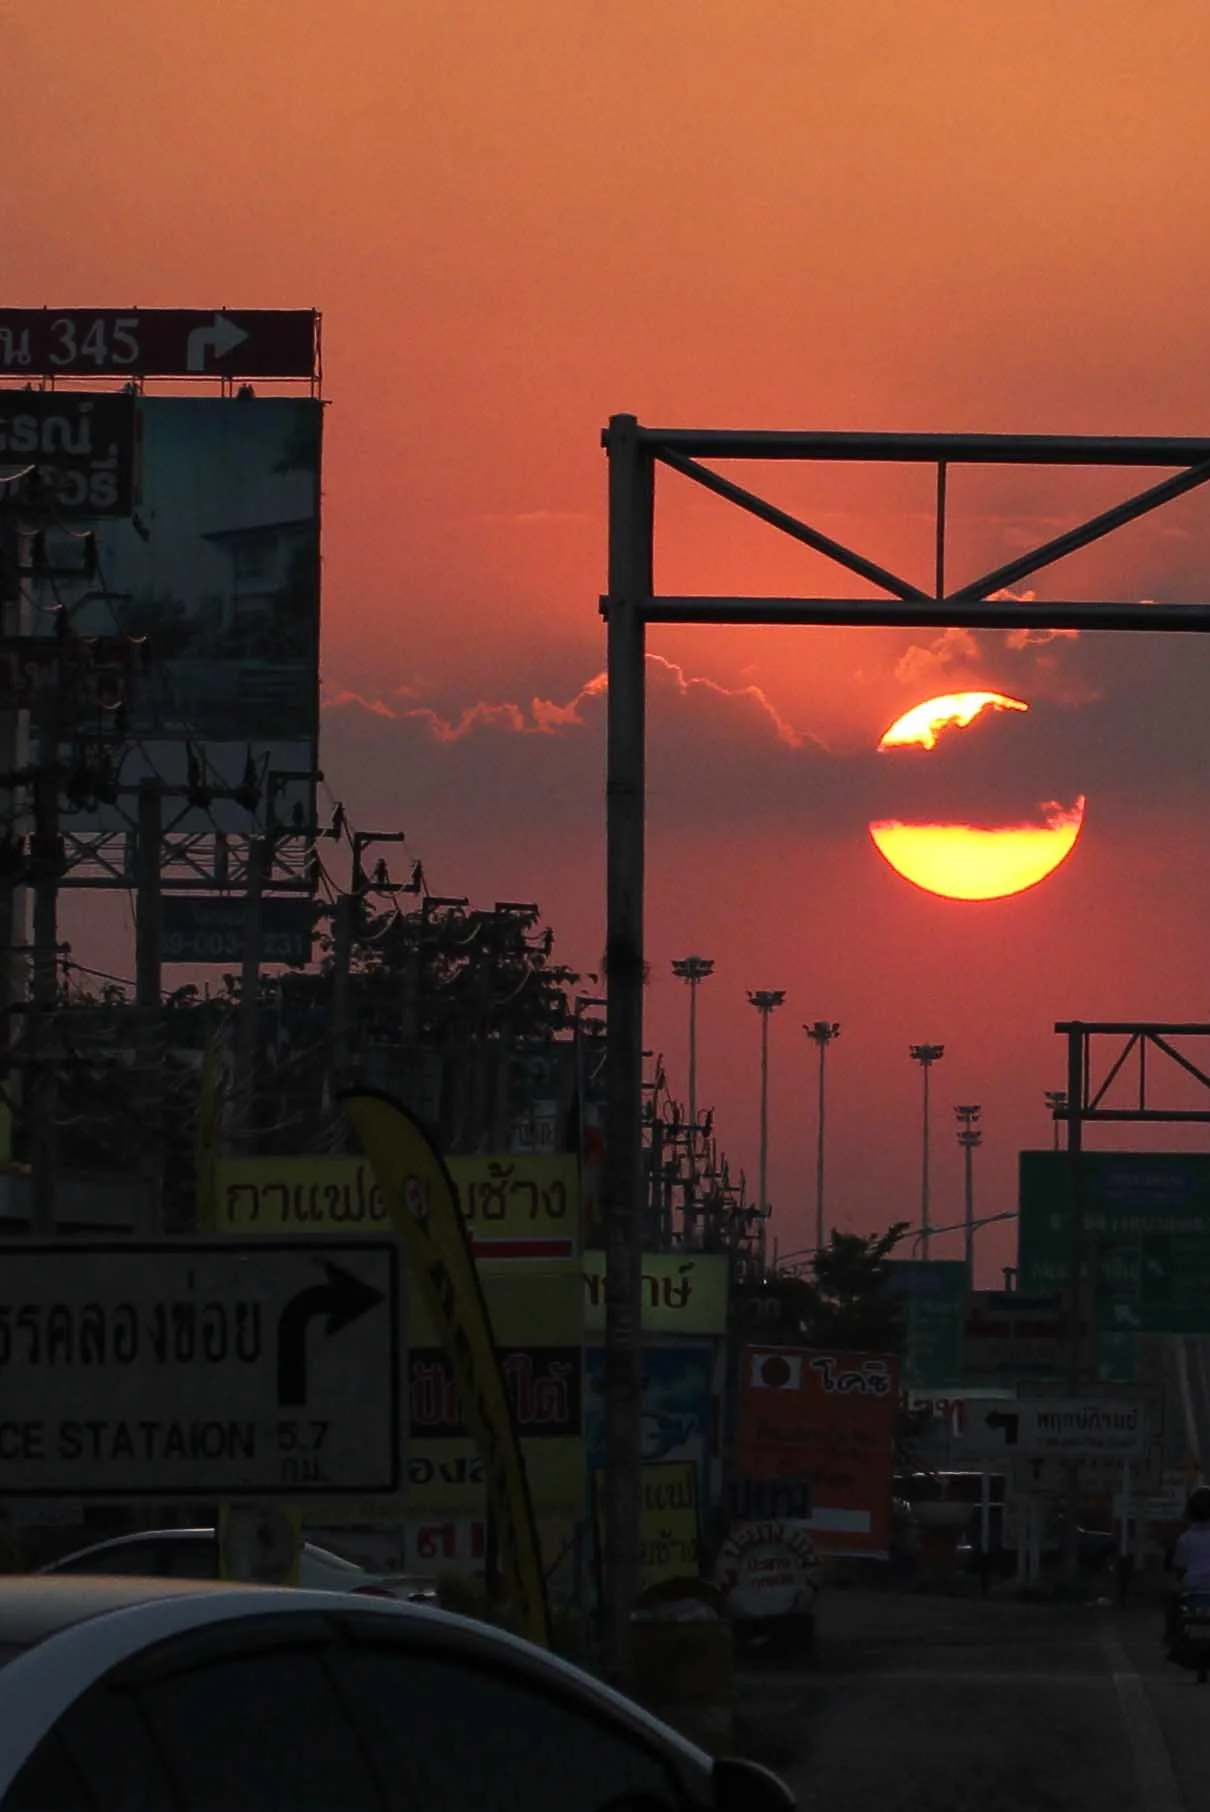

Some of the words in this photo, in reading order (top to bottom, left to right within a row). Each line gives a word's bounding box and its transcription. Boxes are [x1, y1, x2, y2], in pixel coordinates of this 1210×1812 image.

[49, 318, 140, 366] 345
[59, 1420, 254, 1459] STATAION
[278, 1421, 328, 1452] 5.7
